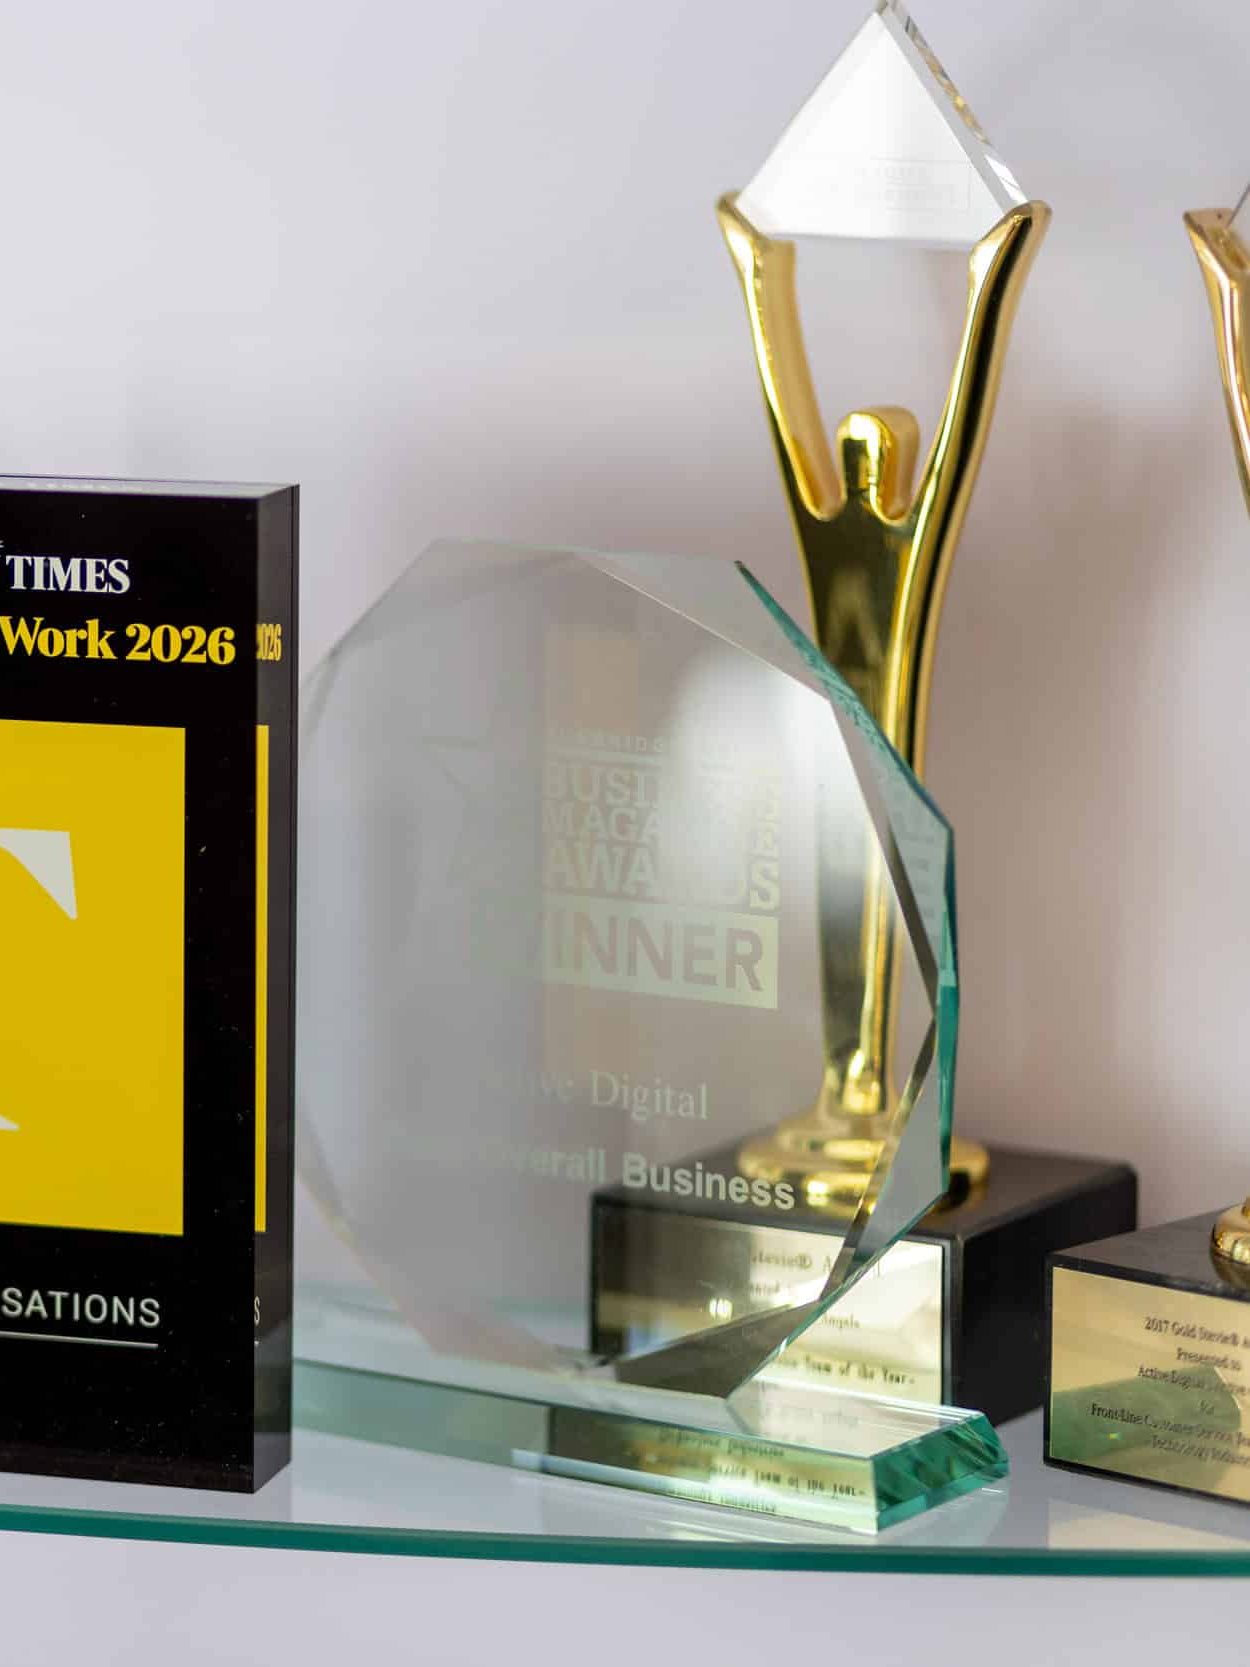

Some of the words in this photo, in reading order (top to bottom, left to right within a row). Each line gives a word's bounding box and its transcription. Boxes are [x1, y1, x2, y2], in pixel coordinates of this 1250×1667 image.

[5, 555, 131, 594] TIMES
[125, 623, 237, 665] 2026
[549, 907, 764, 993] INNER
[590, 1069, 710, 1121] Digital
[508, 1147, 607, 1185] verall
[622, 1152, 796, 1210] Business
[1144, 1316, 1170, 1333] 2017
